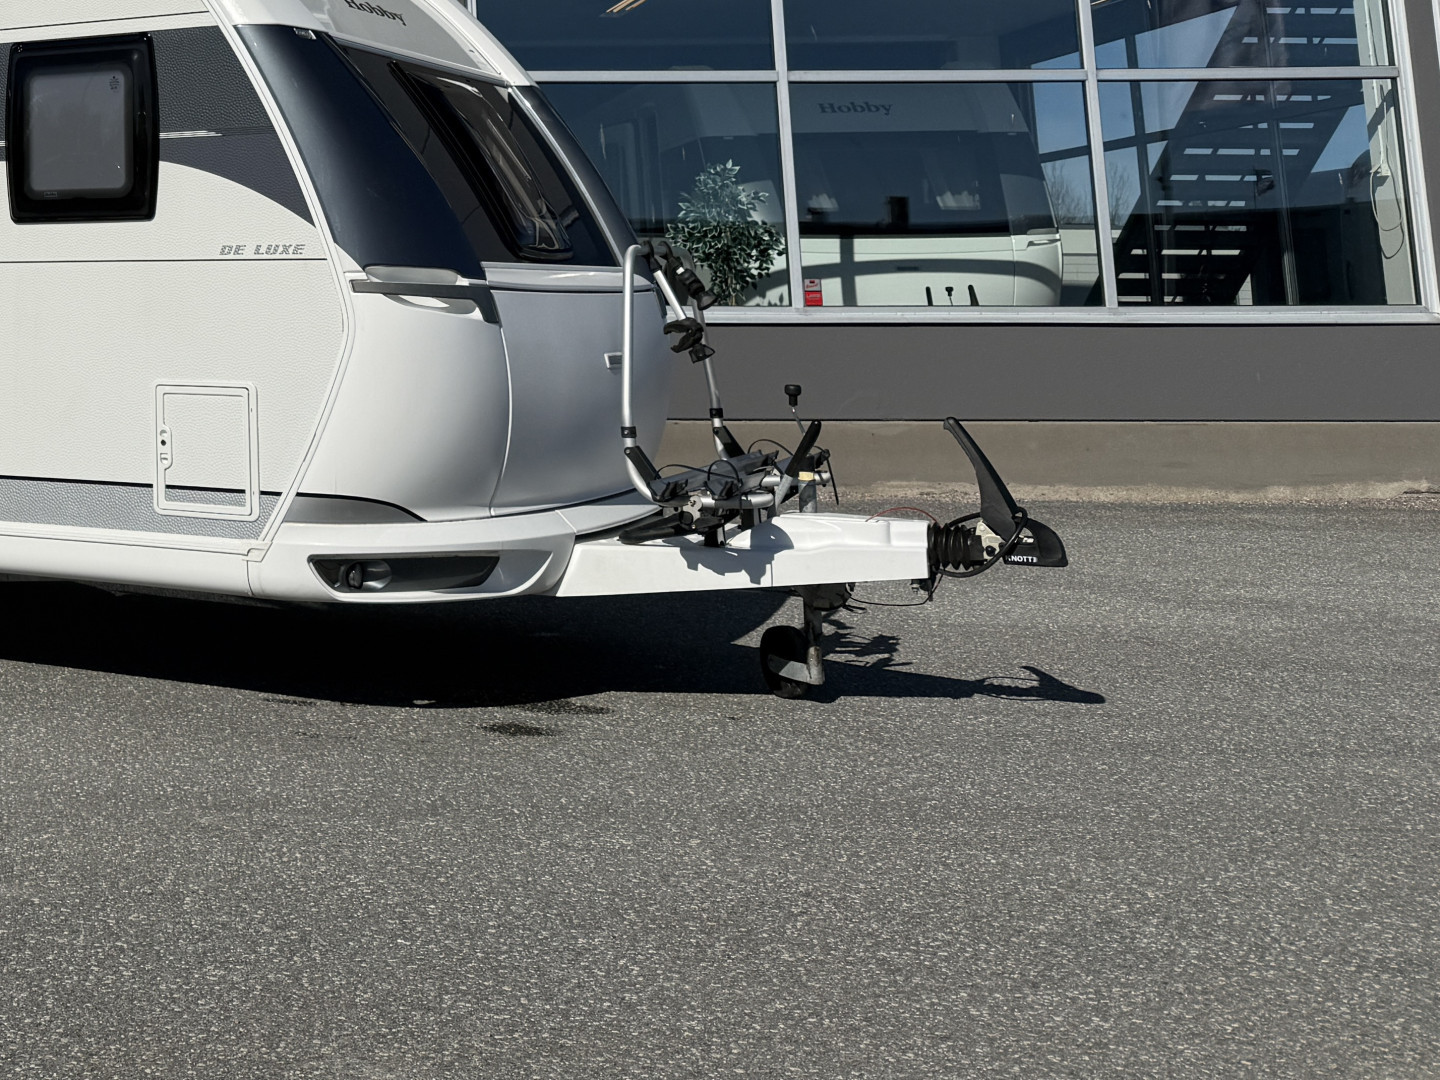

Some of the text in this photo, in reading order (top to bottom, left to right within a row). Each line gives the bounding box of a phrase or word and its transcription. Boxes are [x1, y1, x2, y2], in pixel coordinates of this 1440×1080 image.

[818, 101, 893, 117] Hobby
[219, 244, 306, 256] DE LUXE
